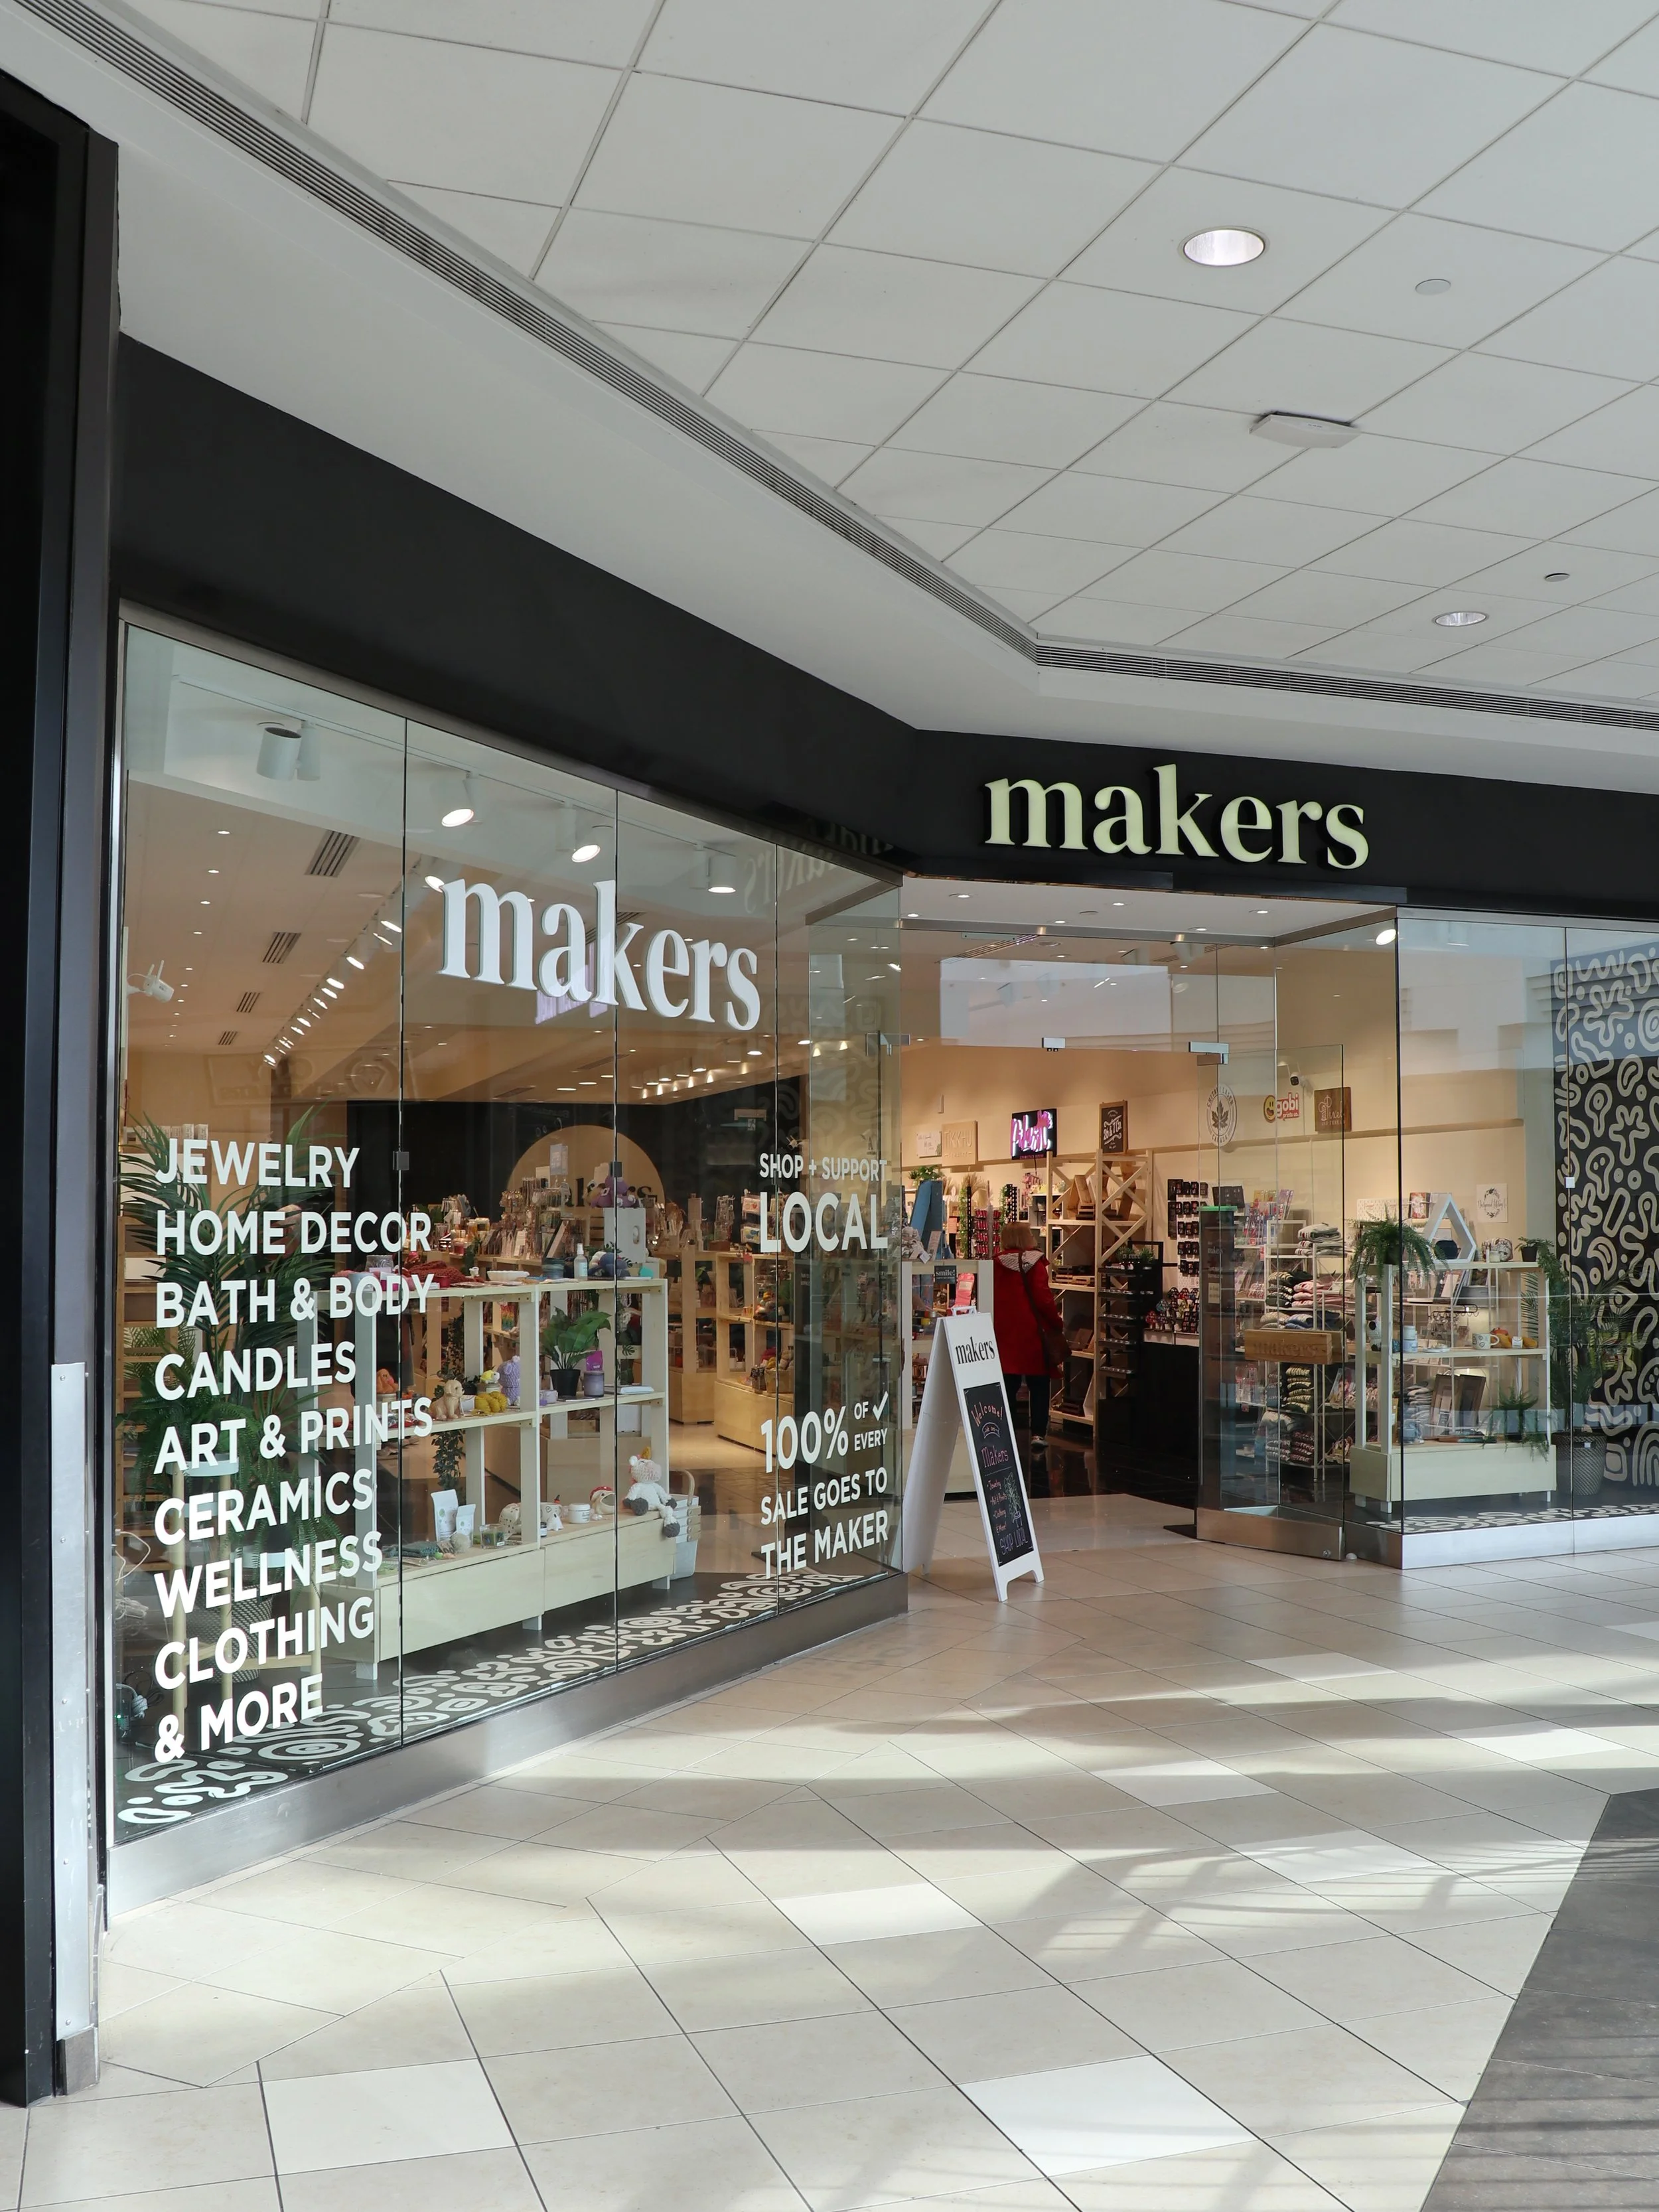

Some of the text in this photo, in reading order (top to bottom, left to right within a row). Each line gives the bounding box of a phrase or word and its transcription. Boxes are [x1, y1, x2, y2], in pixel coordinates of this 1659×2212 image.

[985, 763, 1369, 870] makers
[435, 878, 760, 1031] makers
[1276, 1092, 1299, 1117] gobi
[155, 1138, 360, 1187] JEWELRY
[759, 1153, 887, 1181] SHOP + SUPPORT
[157, 1211, 431, 1257] HOME DECOR
[760, 1191, 888, 1253] LOCAL
[157, 1274, 435, 1328] BATH & BODY
[155, 1342, 356, 1402] CANDLES
[955, 1336, 995, 1364] makers
[1254, 1339, 1317, 1357] makers
[154, 1397, 433, 1474] ART & PRINTS
[760, 1401, 869, 1473] 100% OF
[854, 1428, 888, 1452] EVERY
[971, 1401, 1003, 1427] Welcome!
[981, 1445, 1009, 1468] Makers
[154, 1469, 375, 1545] CERAMICS
[760, 1467, 887, 1526] SALE GOES TO
[761, 1511, 889, 1580] THE MAKER
[1000, 1528, 1029, 1555] SHOP LOCAL
[154, 1530, 383, 1617] WELLNESS
[155, 1597, 374, 1690] CLOTHING
[154, 1672, 324, 1763] & MORE
